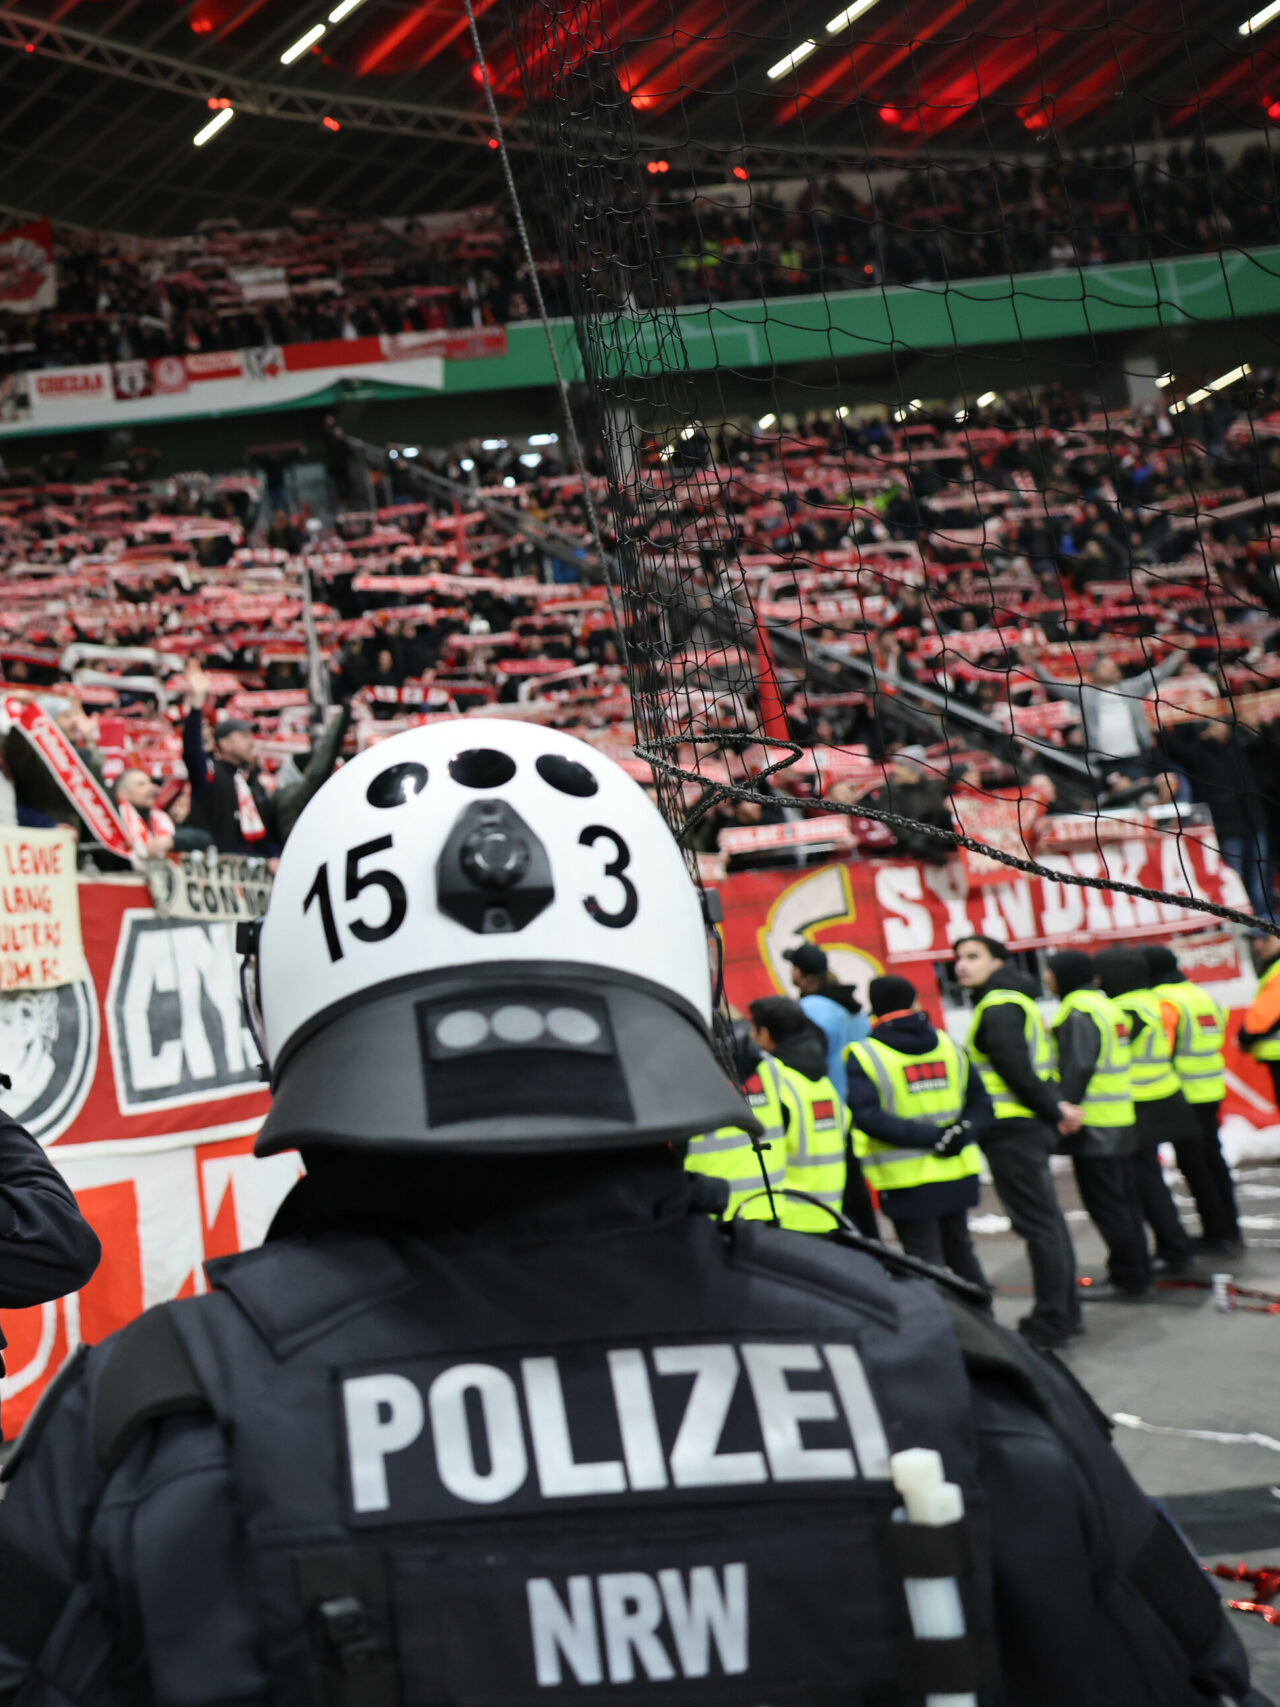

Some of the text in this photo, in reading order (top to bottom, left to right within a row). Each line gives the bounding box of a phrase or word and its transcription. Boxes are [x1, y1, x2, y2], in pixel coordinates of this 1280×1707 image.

[302, 824, 639, 963] 15 3
[343, 1343, 894, 1512] POLIZEI
[526, 1562, 749, 1687] NRW
